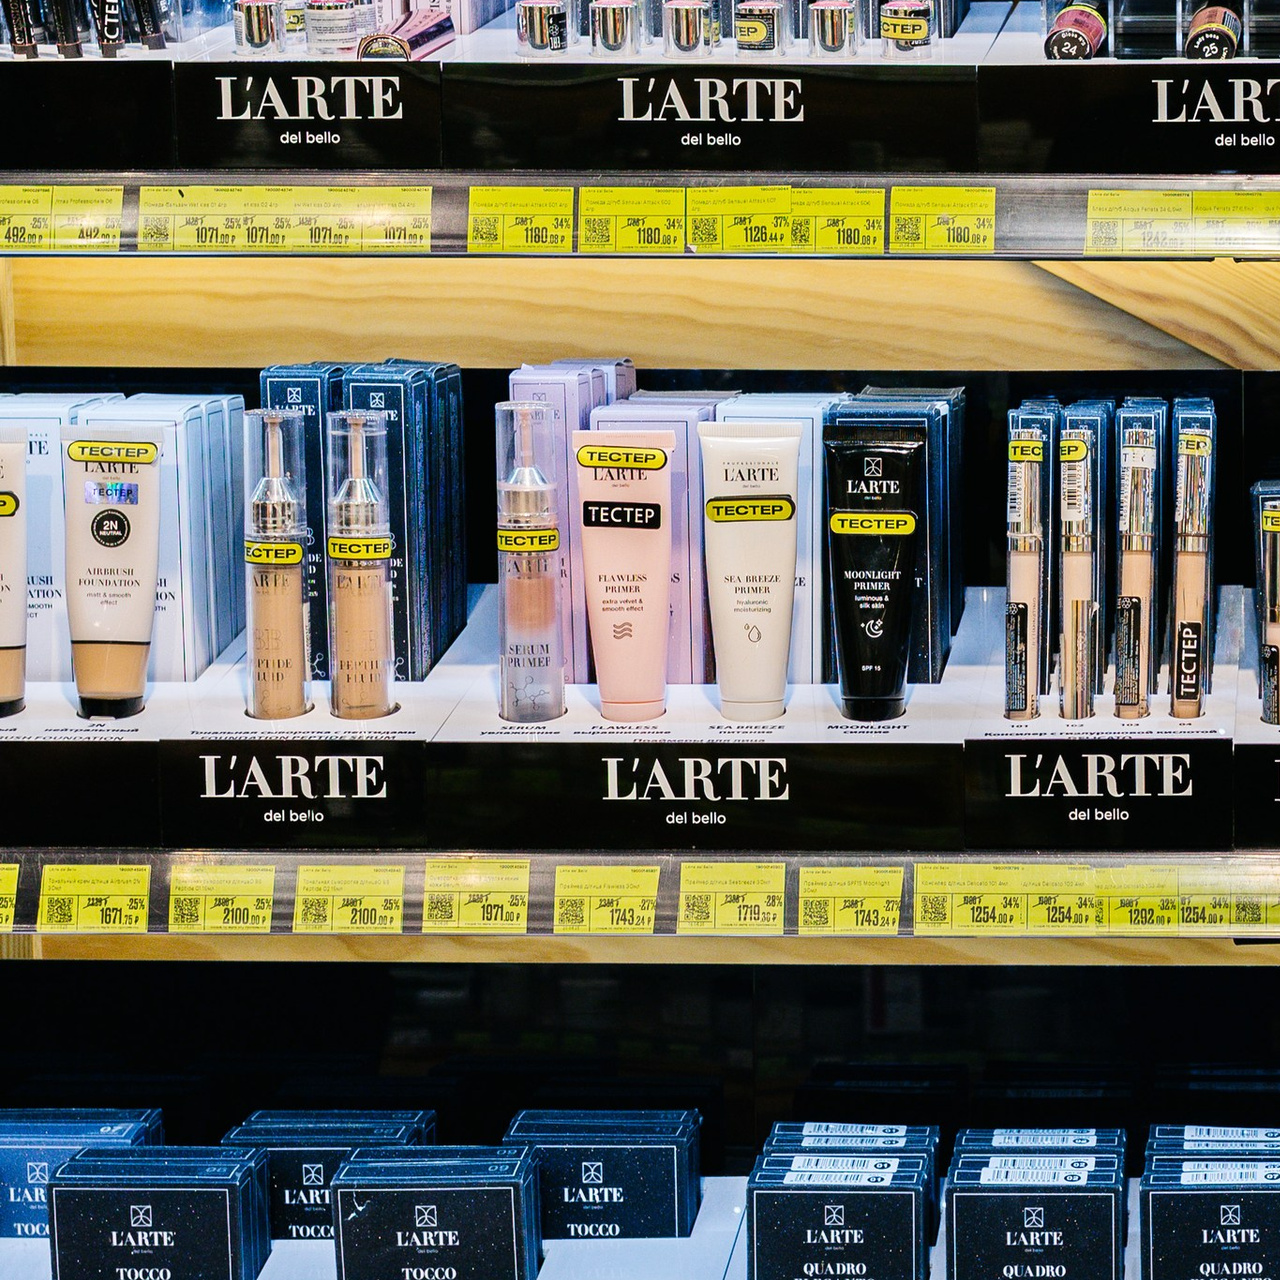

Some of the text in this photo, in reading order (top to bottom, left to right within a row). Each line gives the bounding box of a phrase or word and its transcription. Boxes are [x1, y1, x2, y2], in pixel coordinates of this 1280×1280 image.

[215, 76, 403, 120] L'ARTE
[617, 78, 804, 122] L'ARTE
[1215, 133, 1275, 146] del bello
[847, 480, 900, 494] L'ARTE
[103, 521, 118, 530] 2N
[88, 568, 134, 576] AIRBRUSH
[844, 570, 901, 579] MOONLIGHT
[79, 578, 140, 587] FOUNDATION
[599, 574, 647, 582] FLAWLESS
[746, 575, 779, 583] BREEZE
[735, 586, 770, 594] PRIMER
[854, 582, 890, 590] PRIMER
[737, 599, 768, 607] hyaluronic
[199, 755, 386, 799] L'ARTE
[601, 758, 789, 801] L'ARTE
[1005, 754, 1192, 797] L'ARTE
[401, 1267, 457, 1280] TOCCO
[1003, 1265, 1066, 1279] QUADRO
